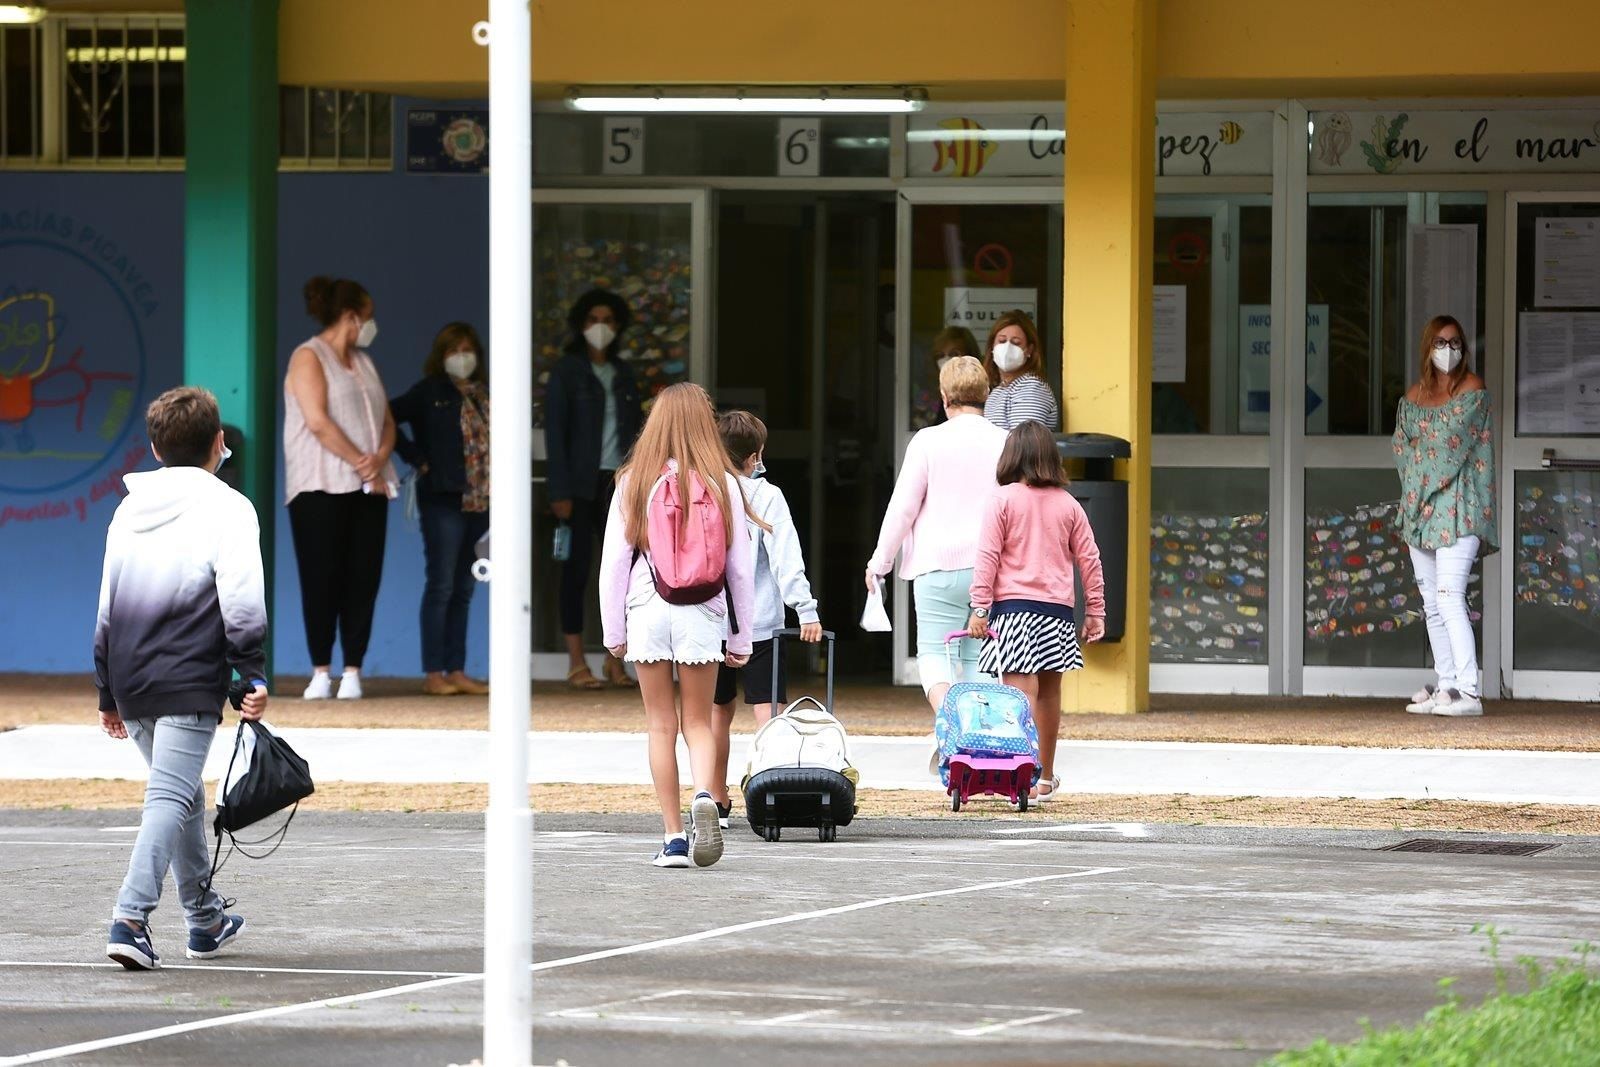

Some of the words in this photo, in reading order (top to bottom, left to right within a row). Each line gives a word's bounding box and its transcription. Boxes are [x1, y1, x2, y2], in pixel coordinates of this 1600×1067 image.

[1158, 130, 1219, 177] pez
[1386, 135, 1428, 163] en
[1455, 116, 1489, 163] el
[1515, 136, 1596, 163] mar
[951, 310, 1034, 320] ADULS
